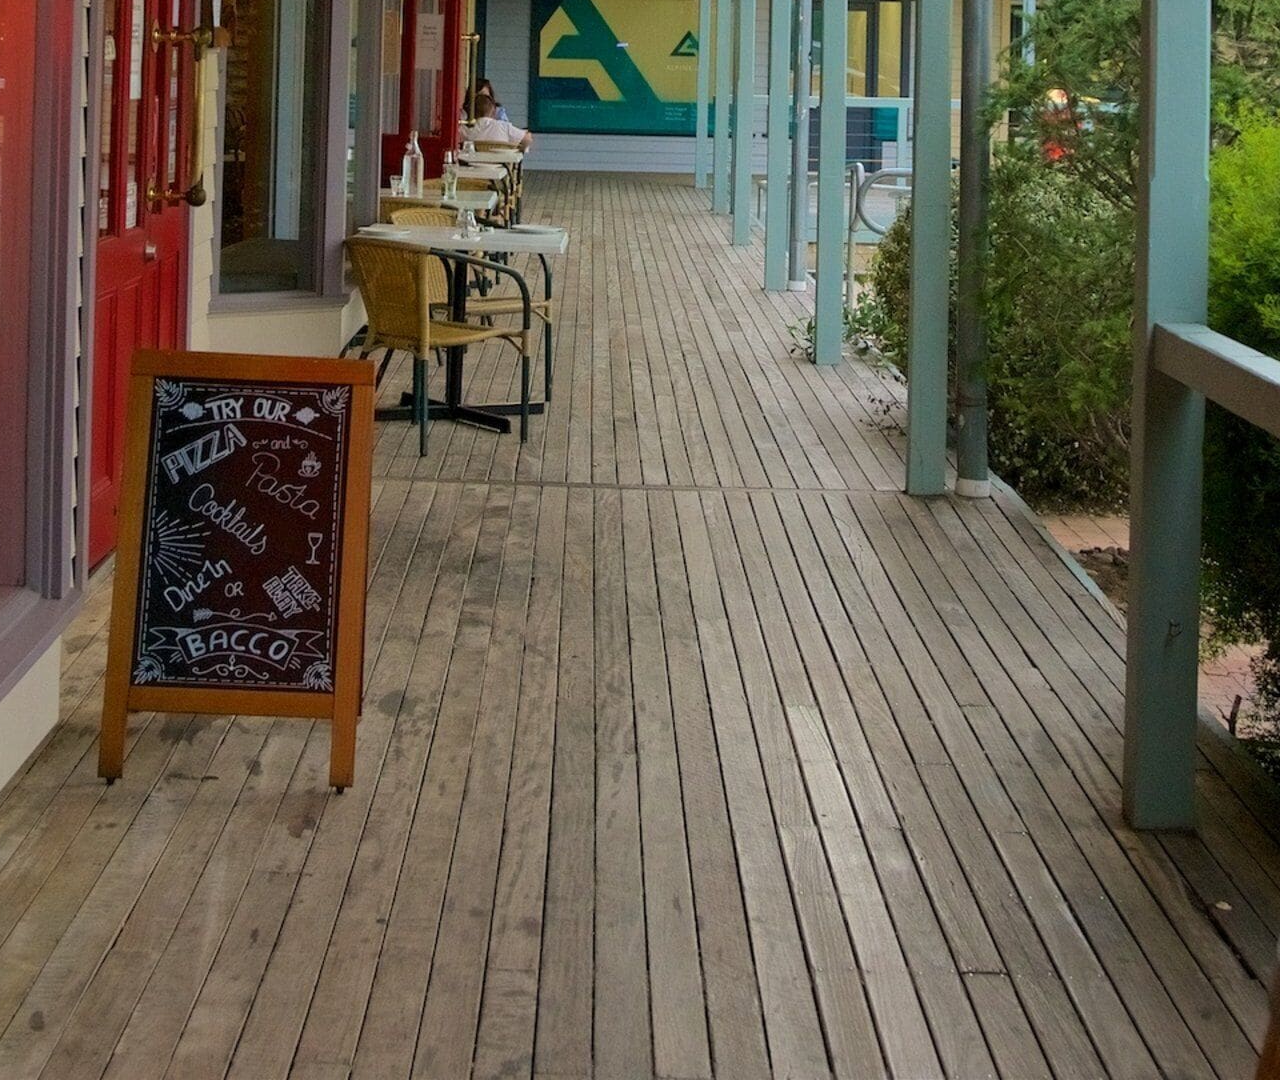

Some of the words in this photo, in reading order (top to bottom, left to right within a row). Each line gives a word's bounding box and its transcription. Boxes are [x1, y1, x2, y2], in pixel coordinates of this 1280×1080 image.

[204, 398, 243, 420] TRY
[254, 400, 291, 422] OUR
[161, 423, 247, 485] PIZZA
[271, 435, 292, 449] and
[245, 452, 321, 520] Pasta
[188, 484, 268, 555] Cocktails
[224, 581, 245, 598] OR
[186, 629, 289, 662] BACCO
